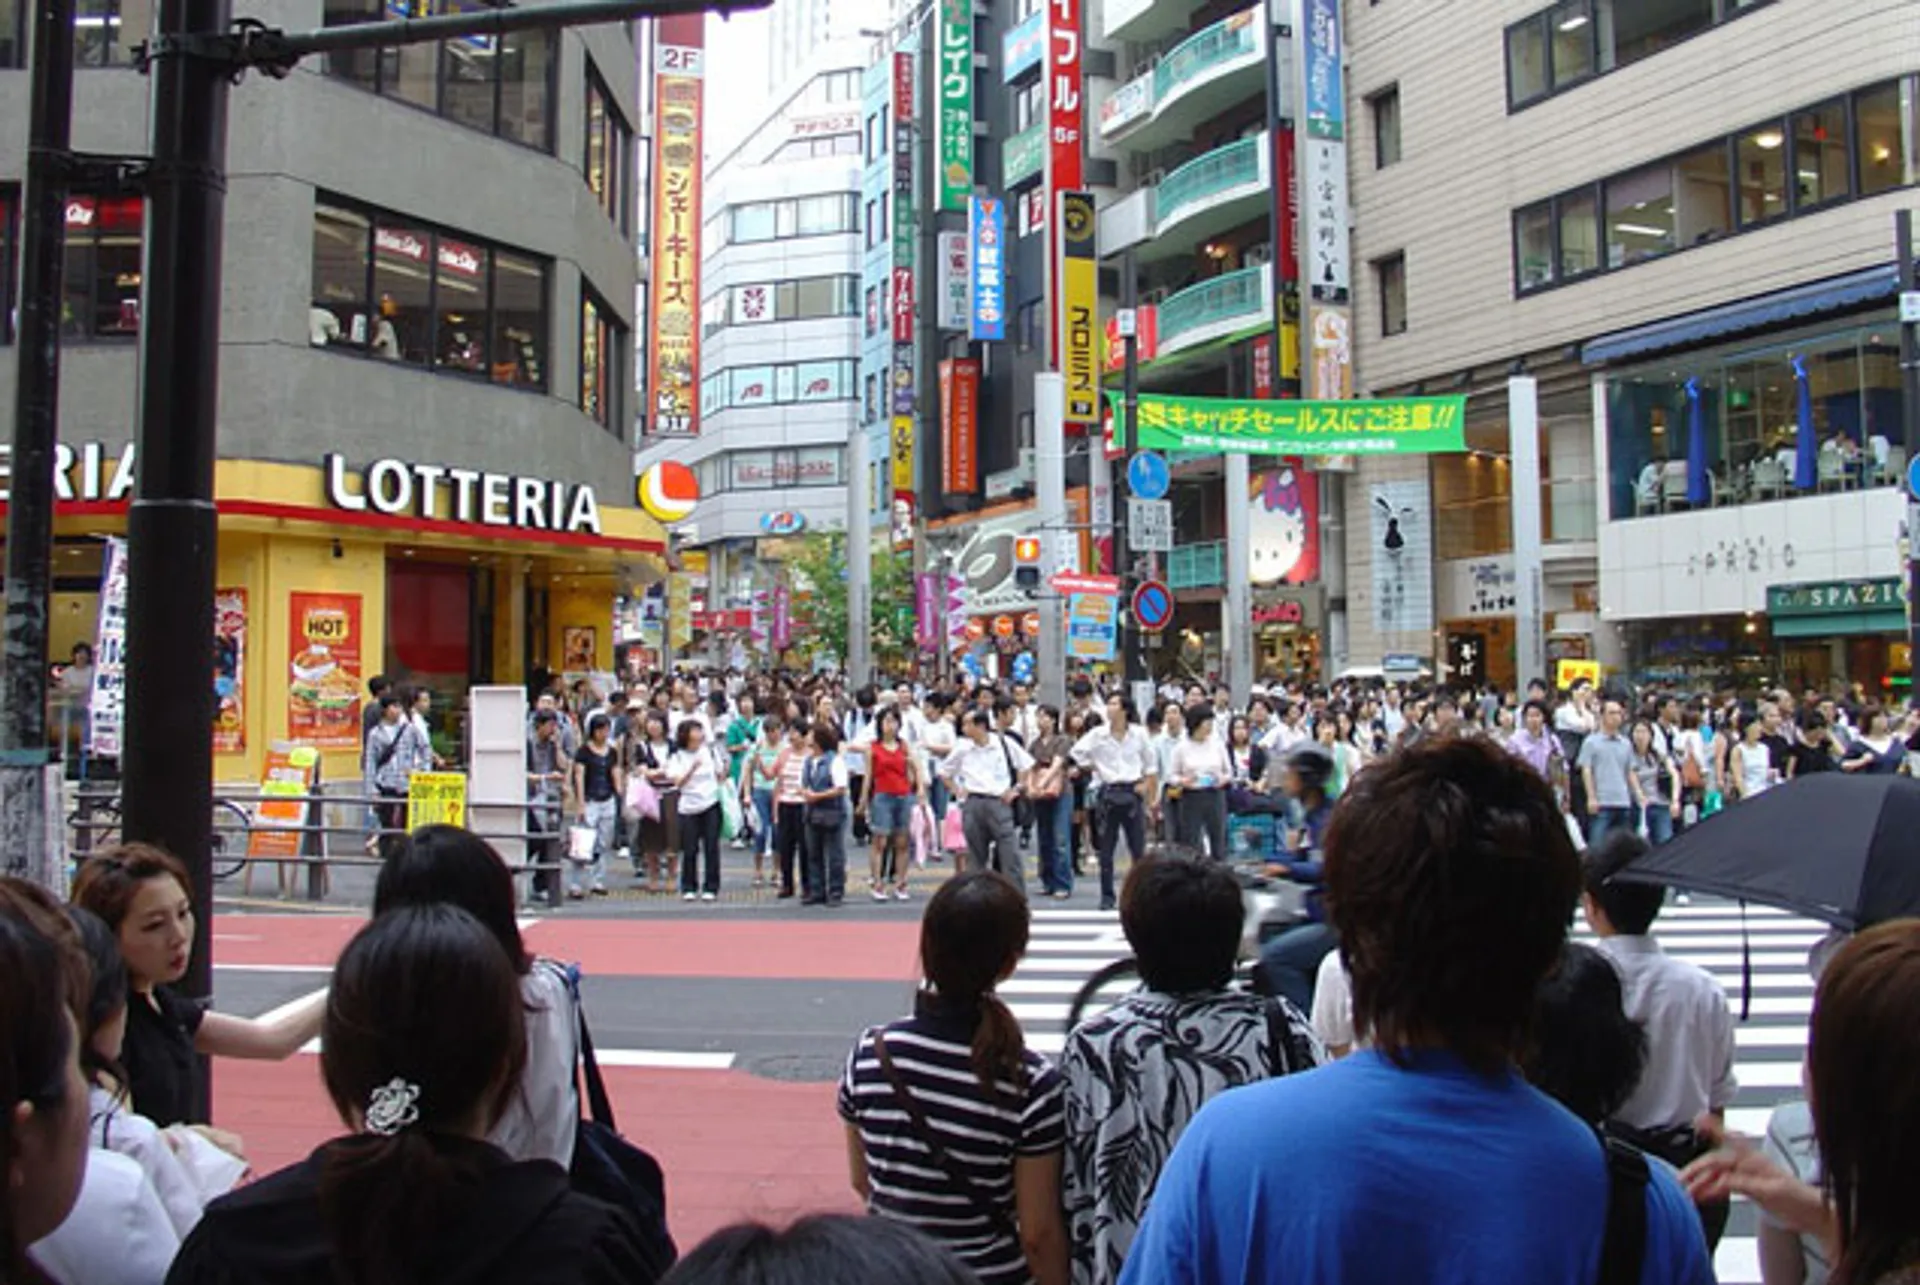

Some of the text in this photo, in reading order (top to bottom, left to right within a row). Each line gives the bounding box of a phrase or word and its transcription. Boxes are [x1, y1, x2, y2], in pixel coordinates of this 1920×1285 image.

[665, 48, 697, 69] 2F
[943, 24, 969, 98] レイク
[663, 171, 692, 304] シェーキーズ
[332, 453, 601, 534] LOTTERIA
[308, 618, 344, 637] HOT
